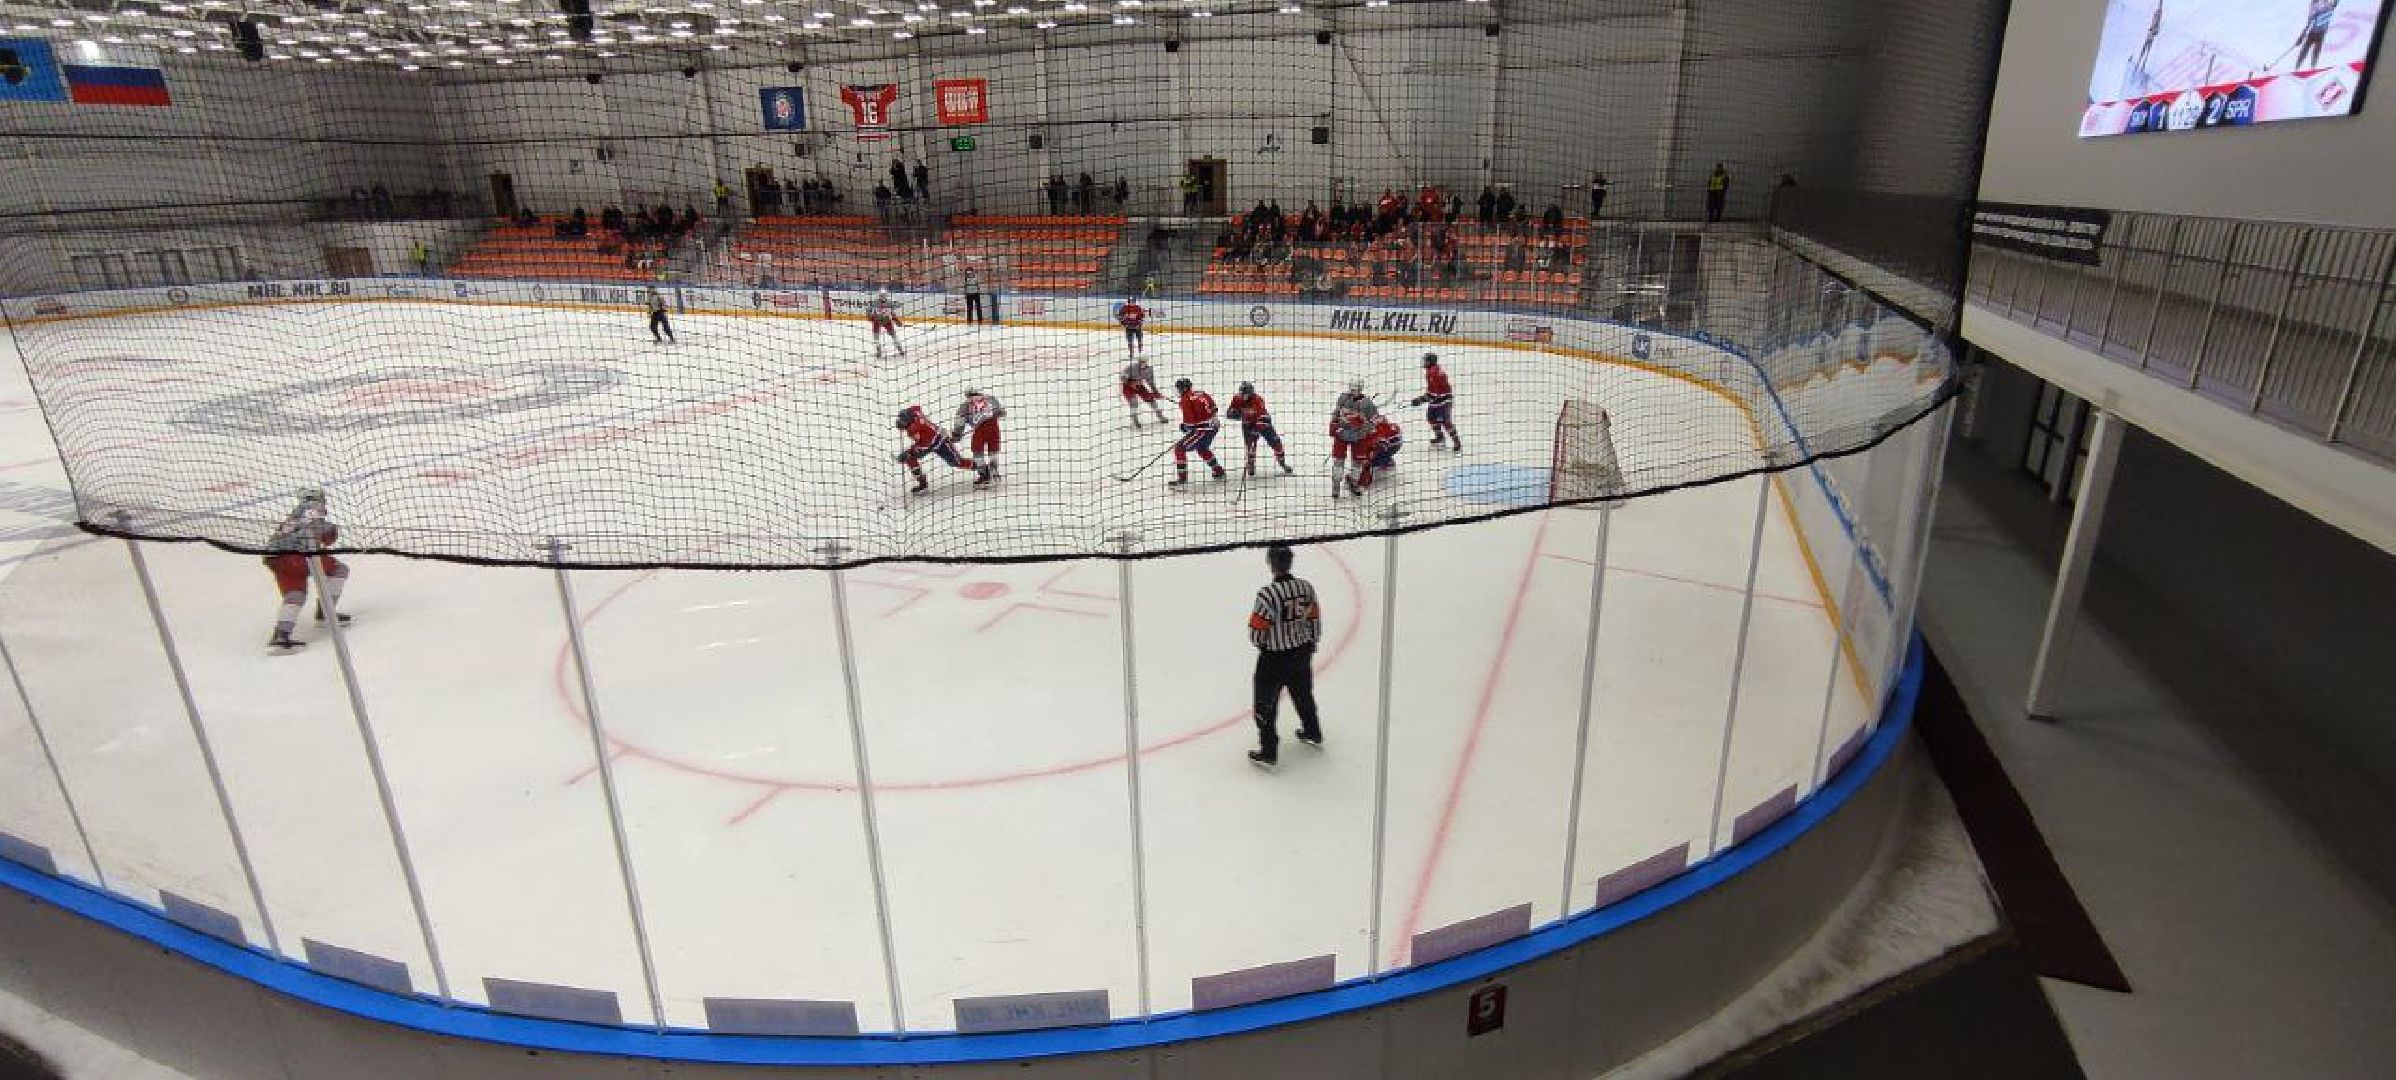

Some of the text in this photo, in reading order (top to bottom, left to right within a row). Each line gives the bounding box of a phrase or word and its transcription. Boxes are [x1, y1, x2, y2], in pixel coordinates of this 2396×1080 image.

[861, 102, 878, 124] 16
[2205, 97, 2222, 125] 2
[2224, 98, 2252, 120] SPR
[247, 281, 351, 299] MHL.KHL.RU
[1330, 308, 1458, 335] MHL.KHL.RU
[1283, 597, 1308, 620] 76
[1477, 990, 1497, 1019] 5
